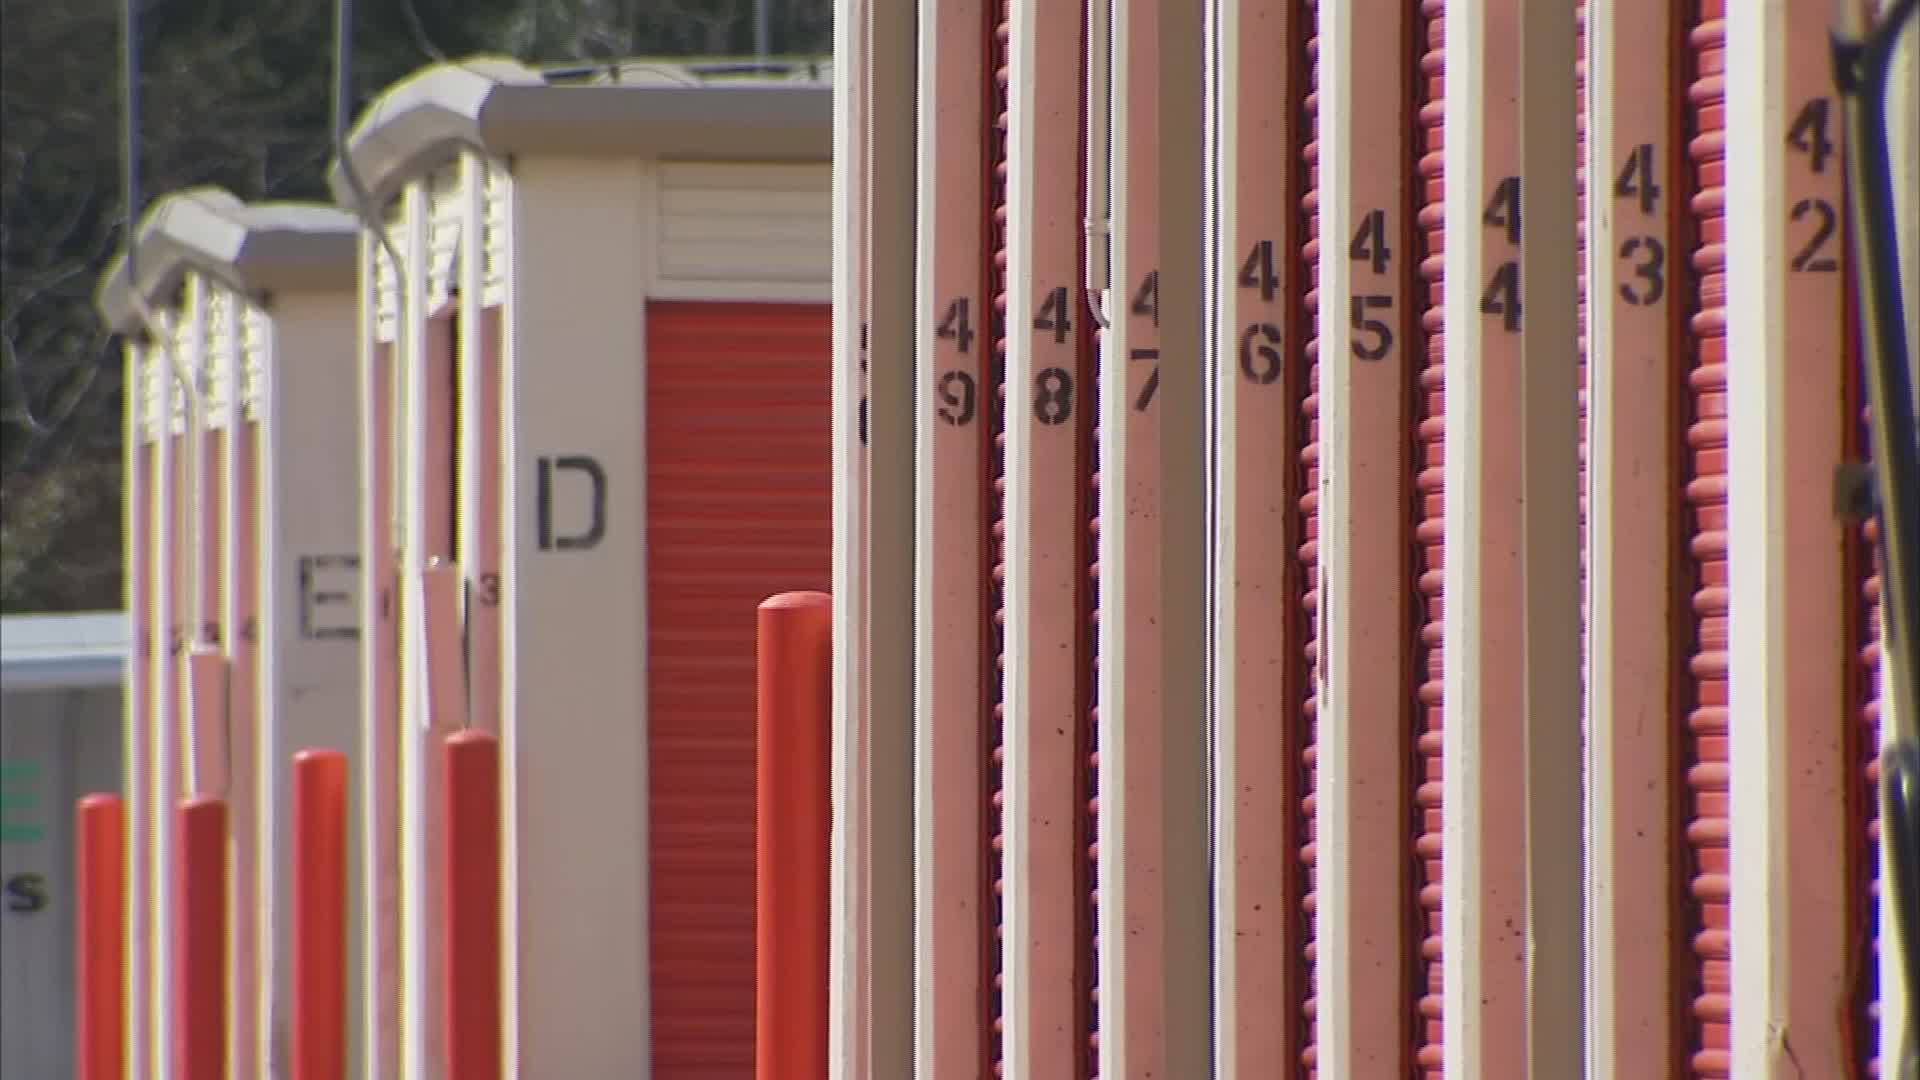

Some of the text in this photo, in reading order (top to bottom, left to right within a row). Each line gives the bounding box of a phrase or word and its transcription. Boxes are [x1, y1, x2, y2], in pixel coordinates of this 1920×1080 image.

[1481, 176, 1521, 332] 44
[1616, 144, 1664, 306] 43
[1786, 98, 1839, 272] 42
[1034, 287, 1073, 425] 48
[1238, 240, 1281, 384] 46
[1350, 210, 1393, 361] 45
[937, 297, 975, 425] 49
[537, 455, 607, 551] D
[298, 555, 360, 640] E
